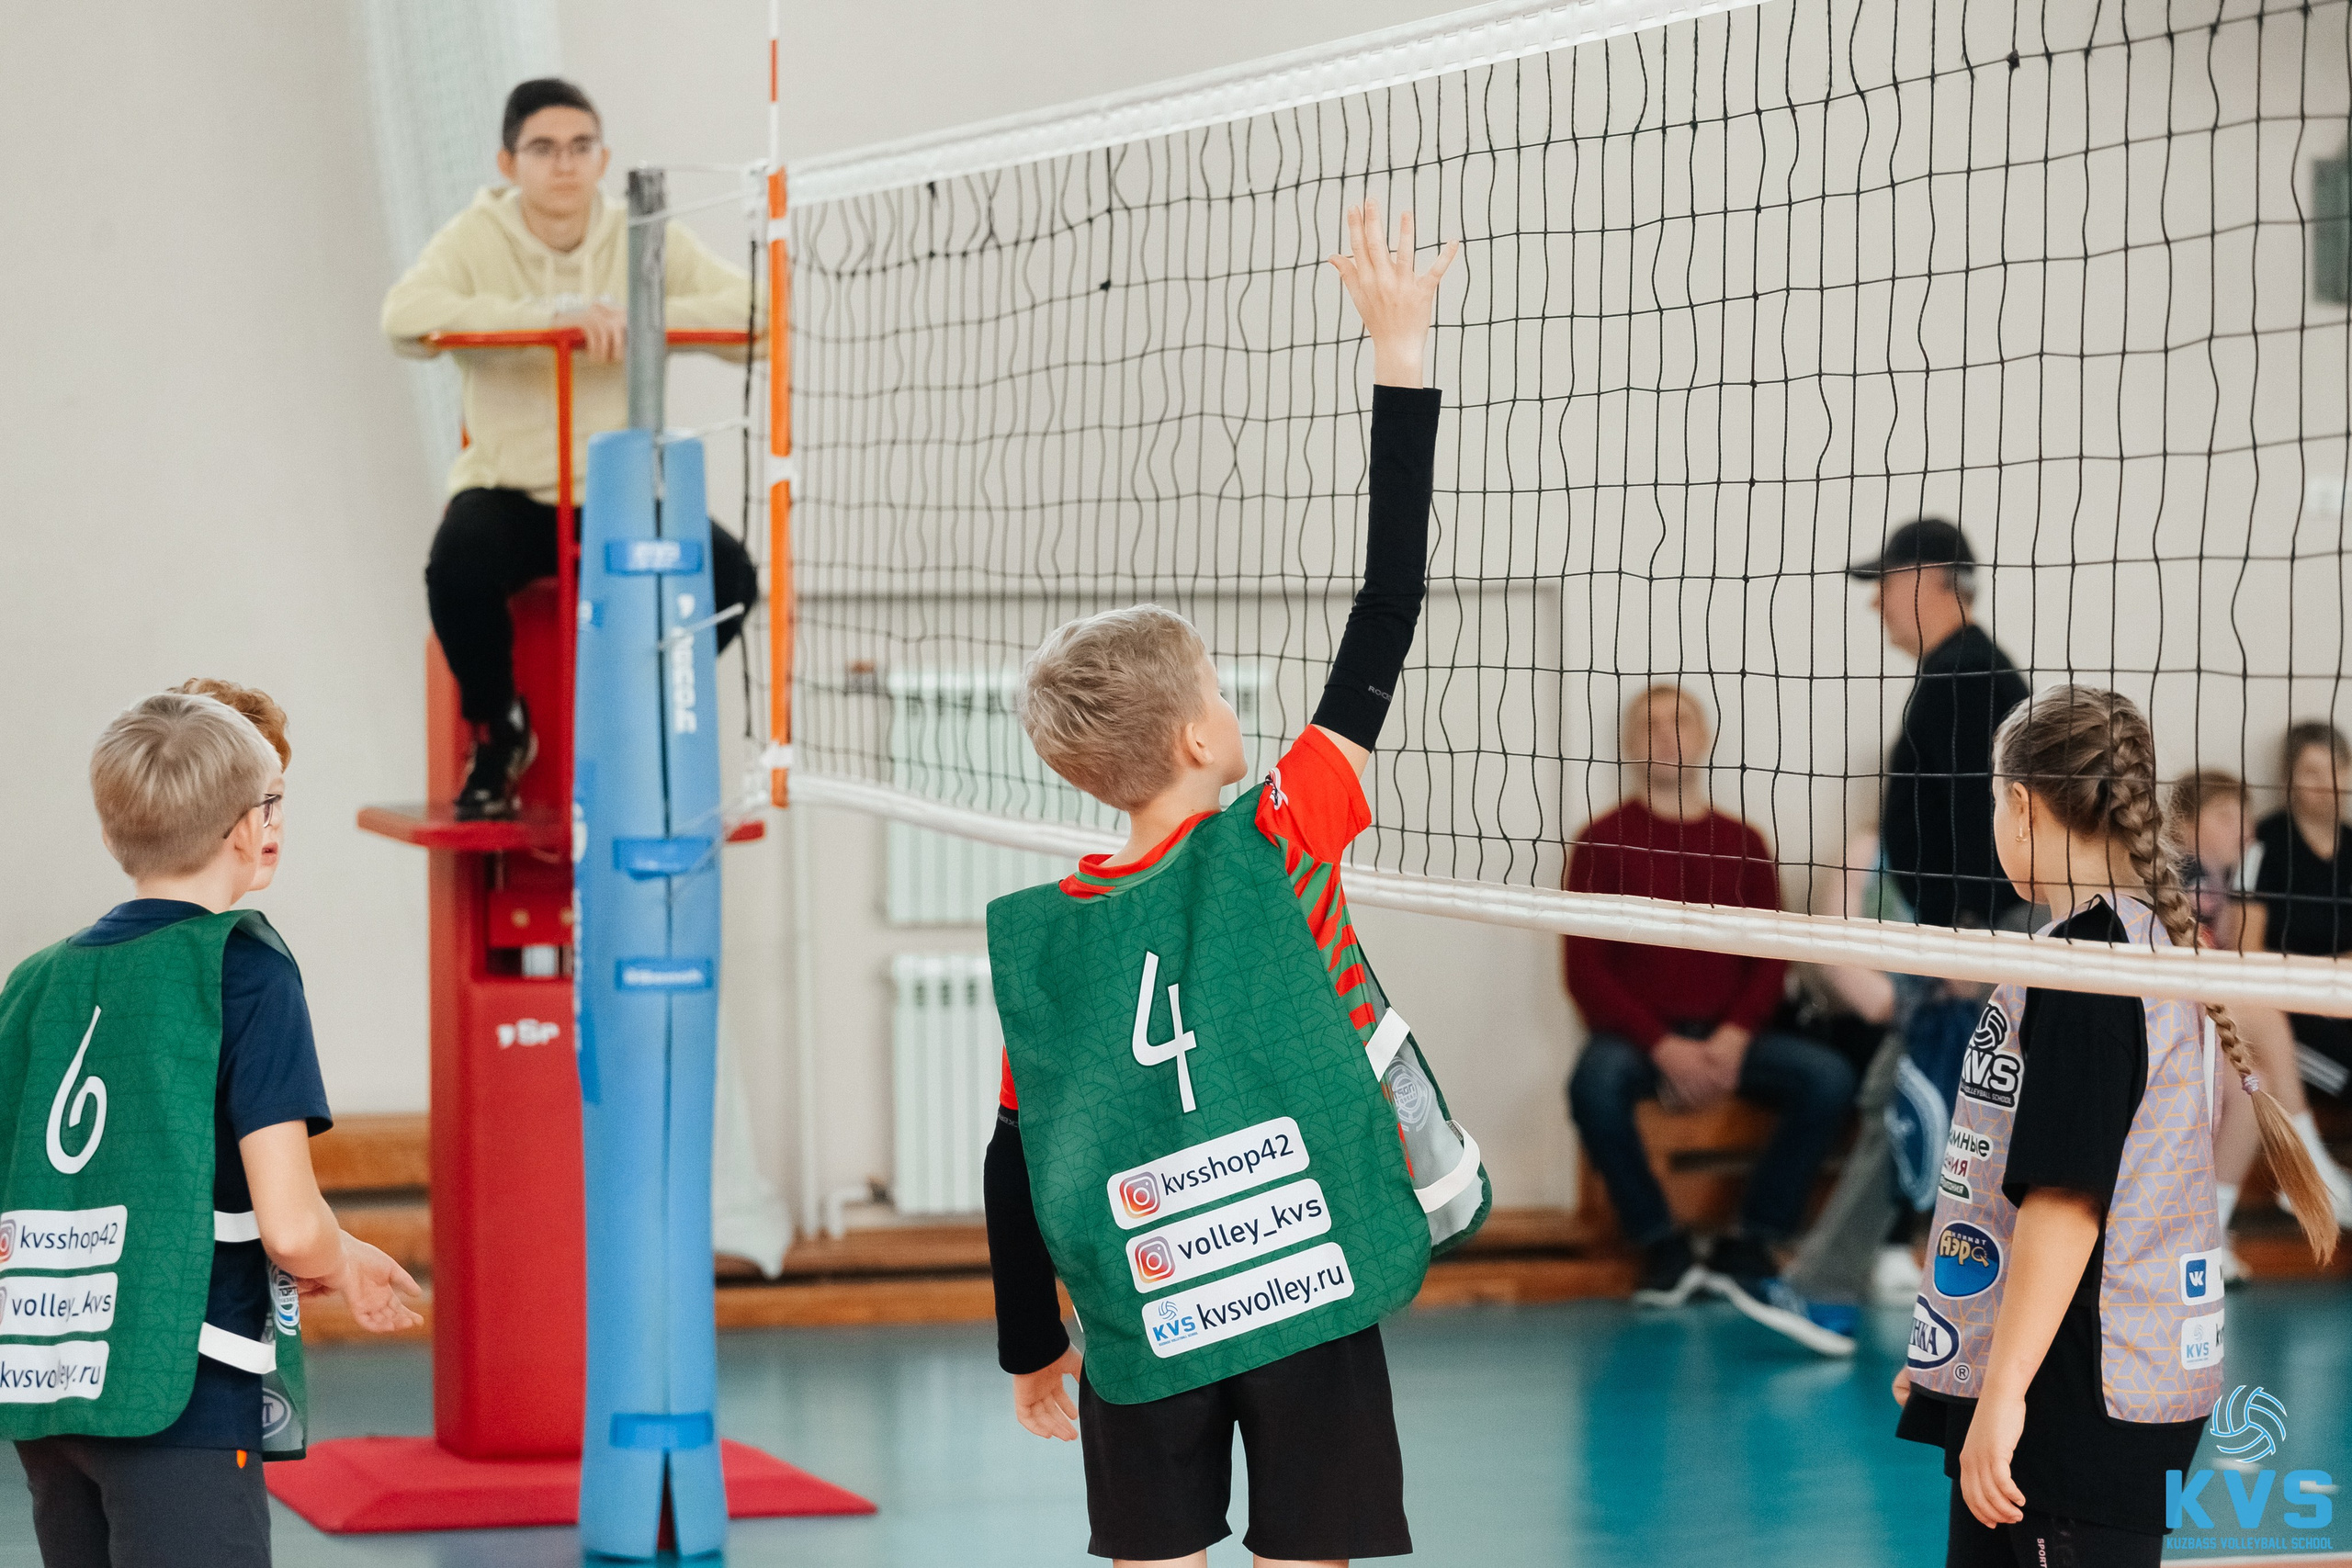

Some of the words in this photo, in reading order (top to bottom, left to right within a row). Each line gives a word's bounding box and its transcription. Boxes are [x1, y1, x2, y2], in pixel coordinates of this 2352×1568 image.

[1132, 951, 1197, 1113] 4
[46, 1005, 107, 1174] 6
[1160, 1134, 1294, 1196] kvsshop42
[20, 1223, 119, 1254] kvsshop42
[1177, 1199, 1322, 1259] volley_kvs
[12, 1291, 112, 1323] volley_kvs
[1196, 1265, 1345, 1330] kvsvolley.ru
[1152, 1315, 1196, 1342] KVS
[2187, 1342, 2209, 1358] KVS
